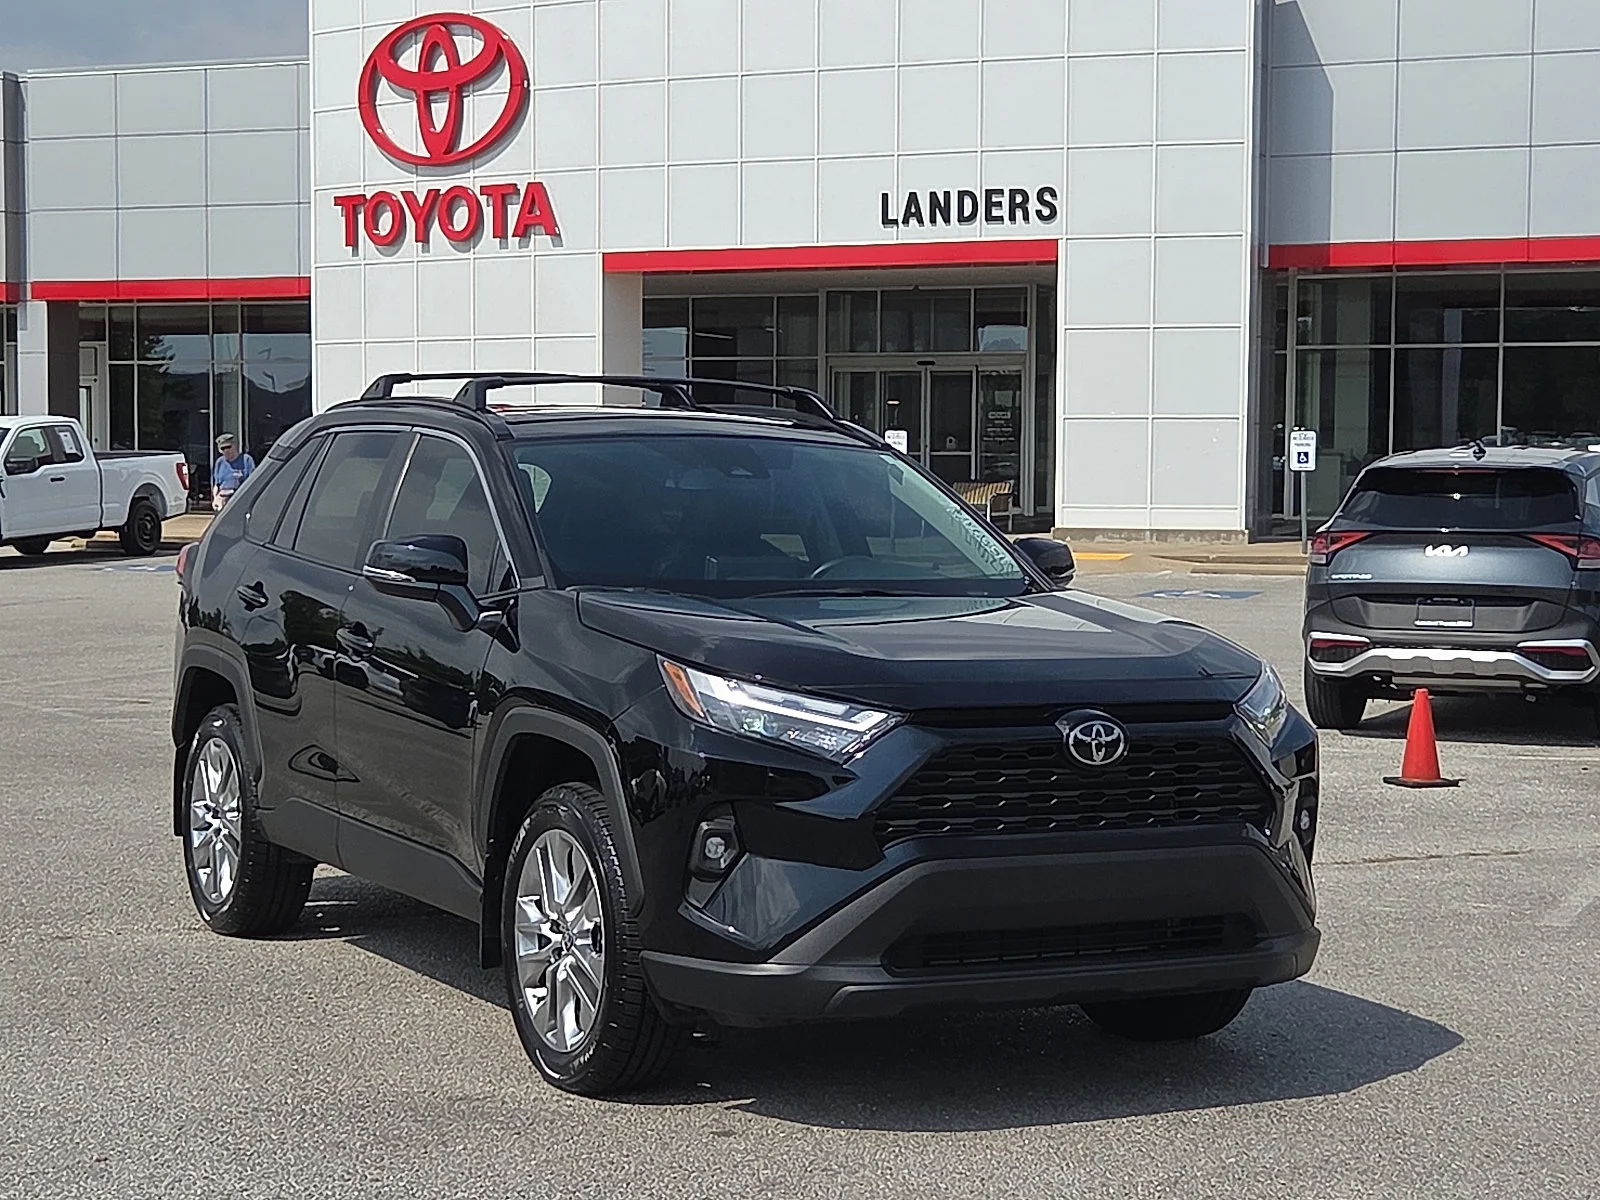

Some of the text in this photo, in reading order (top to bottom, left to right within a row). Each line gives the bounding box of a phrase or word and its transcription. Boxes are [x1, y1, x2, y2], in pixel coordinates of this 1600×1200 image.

[333, 181, 560, 247] TOYOTA
[881, 186, 1058, 227] LANDERS
[1424, 544, 1469, 557] KIA
